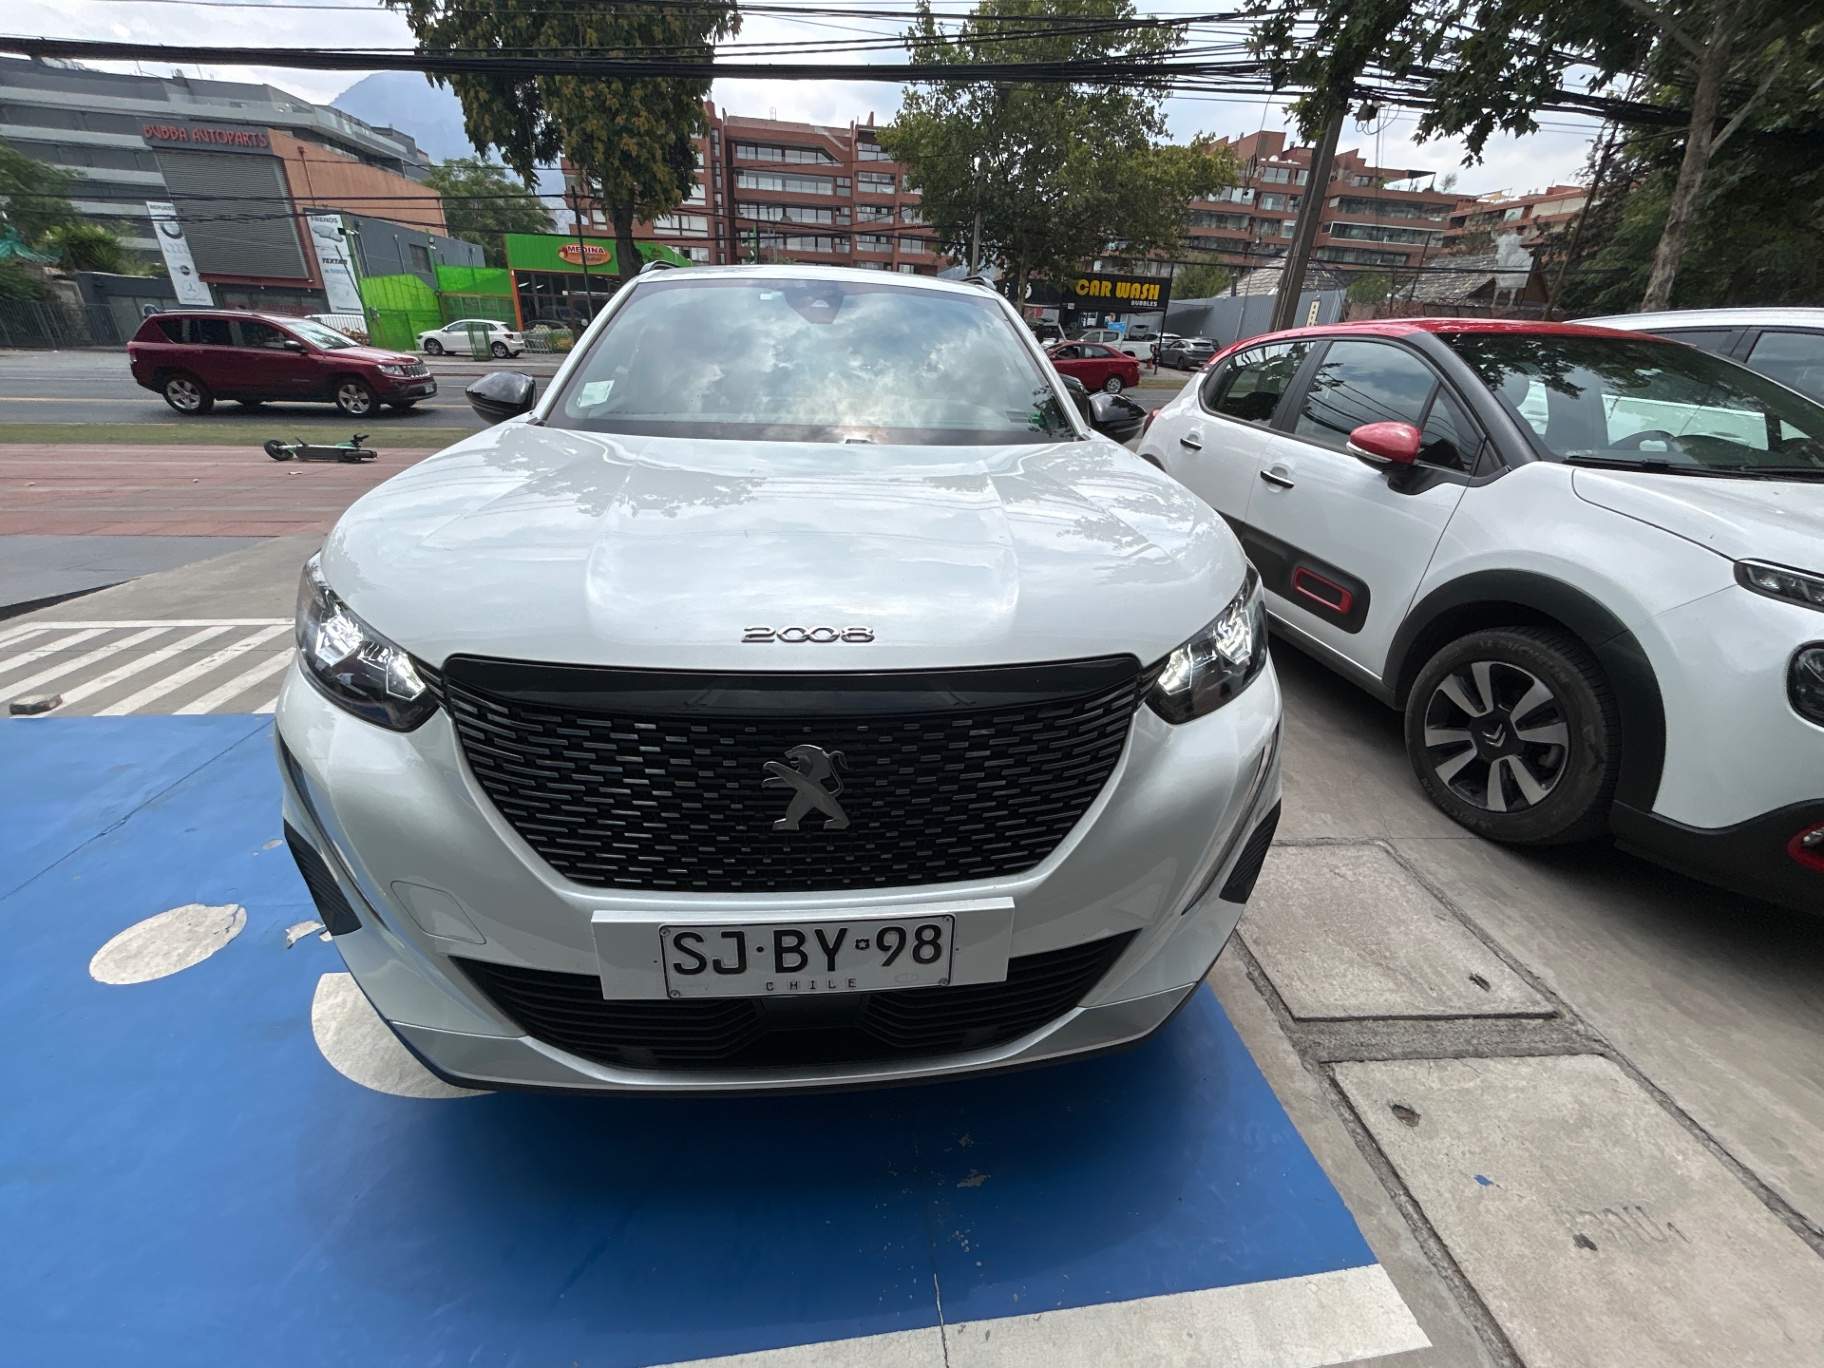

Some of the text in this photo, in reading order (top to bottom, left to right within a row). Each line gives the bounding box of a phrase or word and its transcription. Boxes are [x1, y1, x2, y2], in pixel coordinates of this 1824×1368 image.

[191, 127, 269, 148] AUTOPARTS
[567, 246, 605, 254] MEDINA
[1075, 279, 1160, 299] CAR WASH
[741, 626, 875, 643] 2008
[766, 978, 857, 991] CHILE
